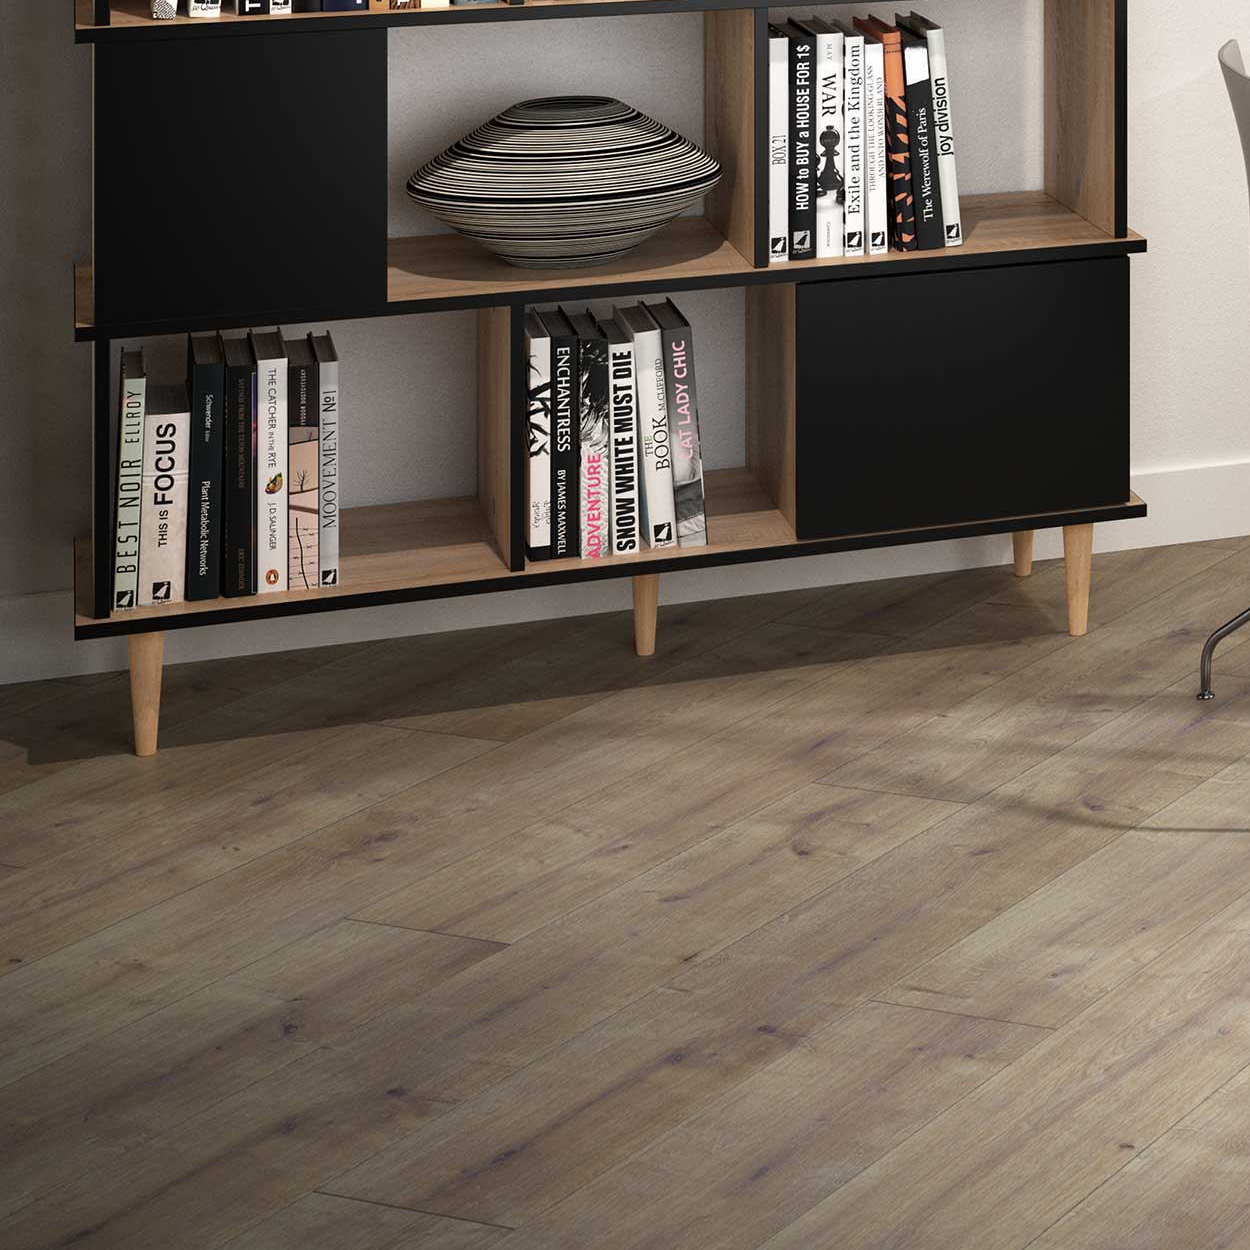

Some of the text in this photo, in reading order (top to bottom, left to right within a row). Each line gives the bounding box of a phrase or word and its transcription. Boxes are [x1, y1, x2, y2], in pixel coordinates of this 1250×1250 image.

[796, 44, 812, 211] HOW to BUY a HOUSE FOR 1$
[822, 73, 837, 118] WAR
[848, 44, 864, 214] Exile and the Kingdom
[932, 77, 954, 157] joy division
[772, 144, 787, 165] BOX
[917, 107, 934, 222] The Werewolf of Paris
[268, 368, 276, 386] THE
[556, 347, 571, 452] ENCHANTRESS
[672, 340, 688, 379] CHIC
[204, 394, 213, 429] Schwender
[267, 388, 276, 430] CATCHER
[643, 434, 654, 457] THE
[652, 358, 670, 472] BOOK M.CLIFFORD
[676, 383, 691, 424] LADY
[116, 391, 142, 574] BEST NOIR ELLROY
[154, 422, 177, 548] THIS IS FOCUS
[268, 452, 276, 468] RYE
[322, 419, 337, 528] MOOVEMENT
[612, 351, 636, 551] SNOW WHITE MUST DIE
[200, 480, 210, 576] Plant Metabolic Networks
[267, 516, 276, 550] SALINGER
[557, 470, 566, 555] BY JAMES MAXWELL
[587, 454, 602, 559] ADVENTURE
